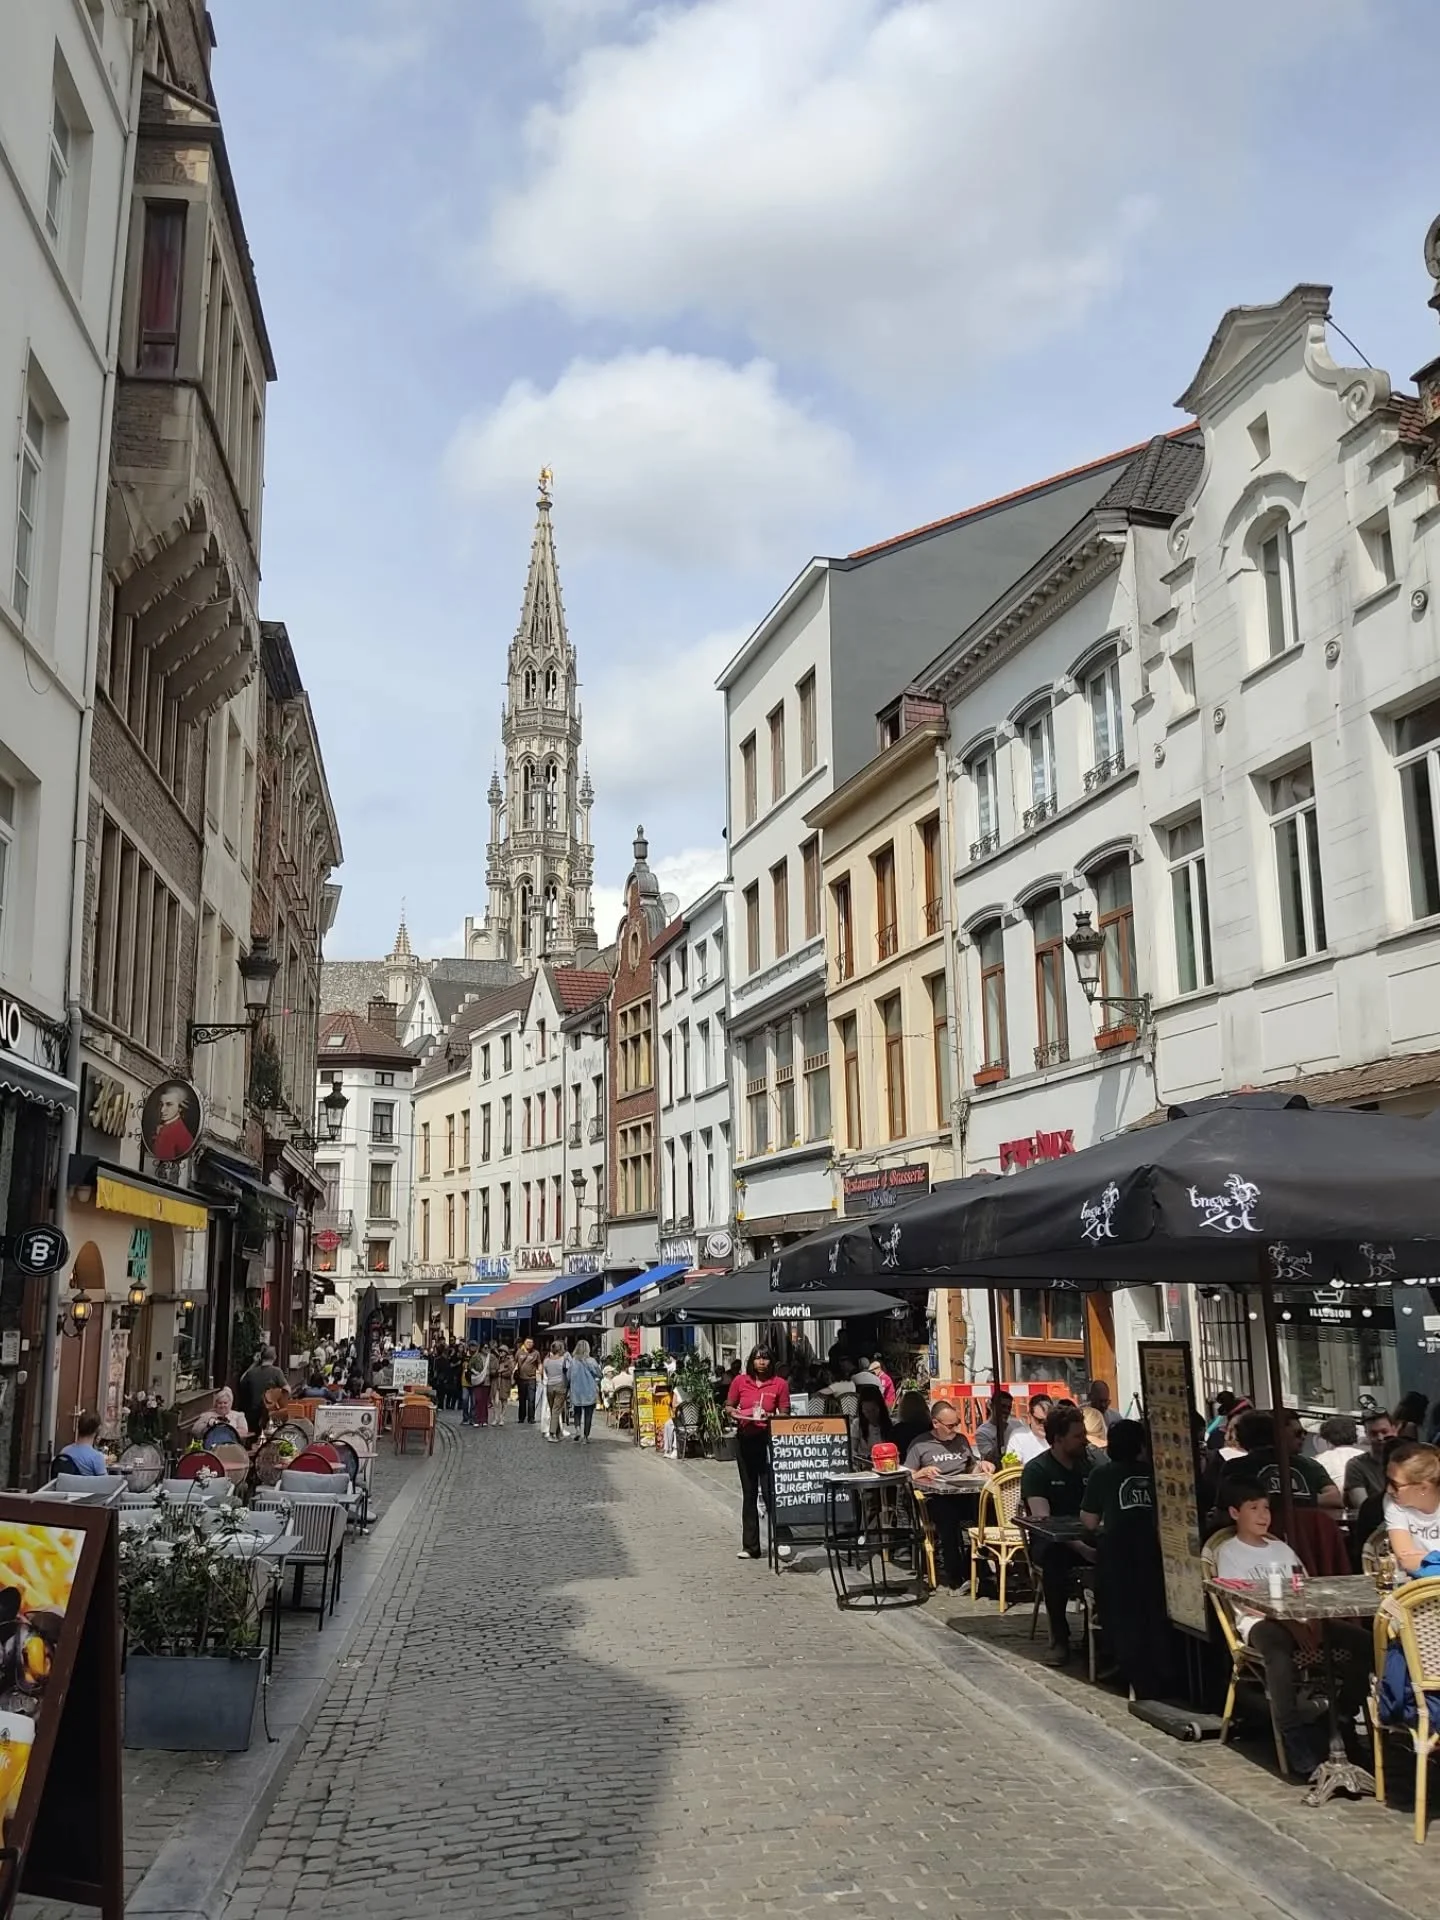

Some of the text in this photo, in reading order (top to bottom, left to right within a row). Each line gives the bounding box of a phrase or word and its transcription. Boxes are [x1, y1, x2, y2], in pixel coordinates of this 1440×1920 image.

[1199, 1207, 1264, 1233] Zot
[1080, 1216, 1119, 1240] Zot
[931, 1453, 962, 1462] WRX
[774, 1472, 806, 1483] MOULE
[774, 1481, 813, 1495] BURGER
